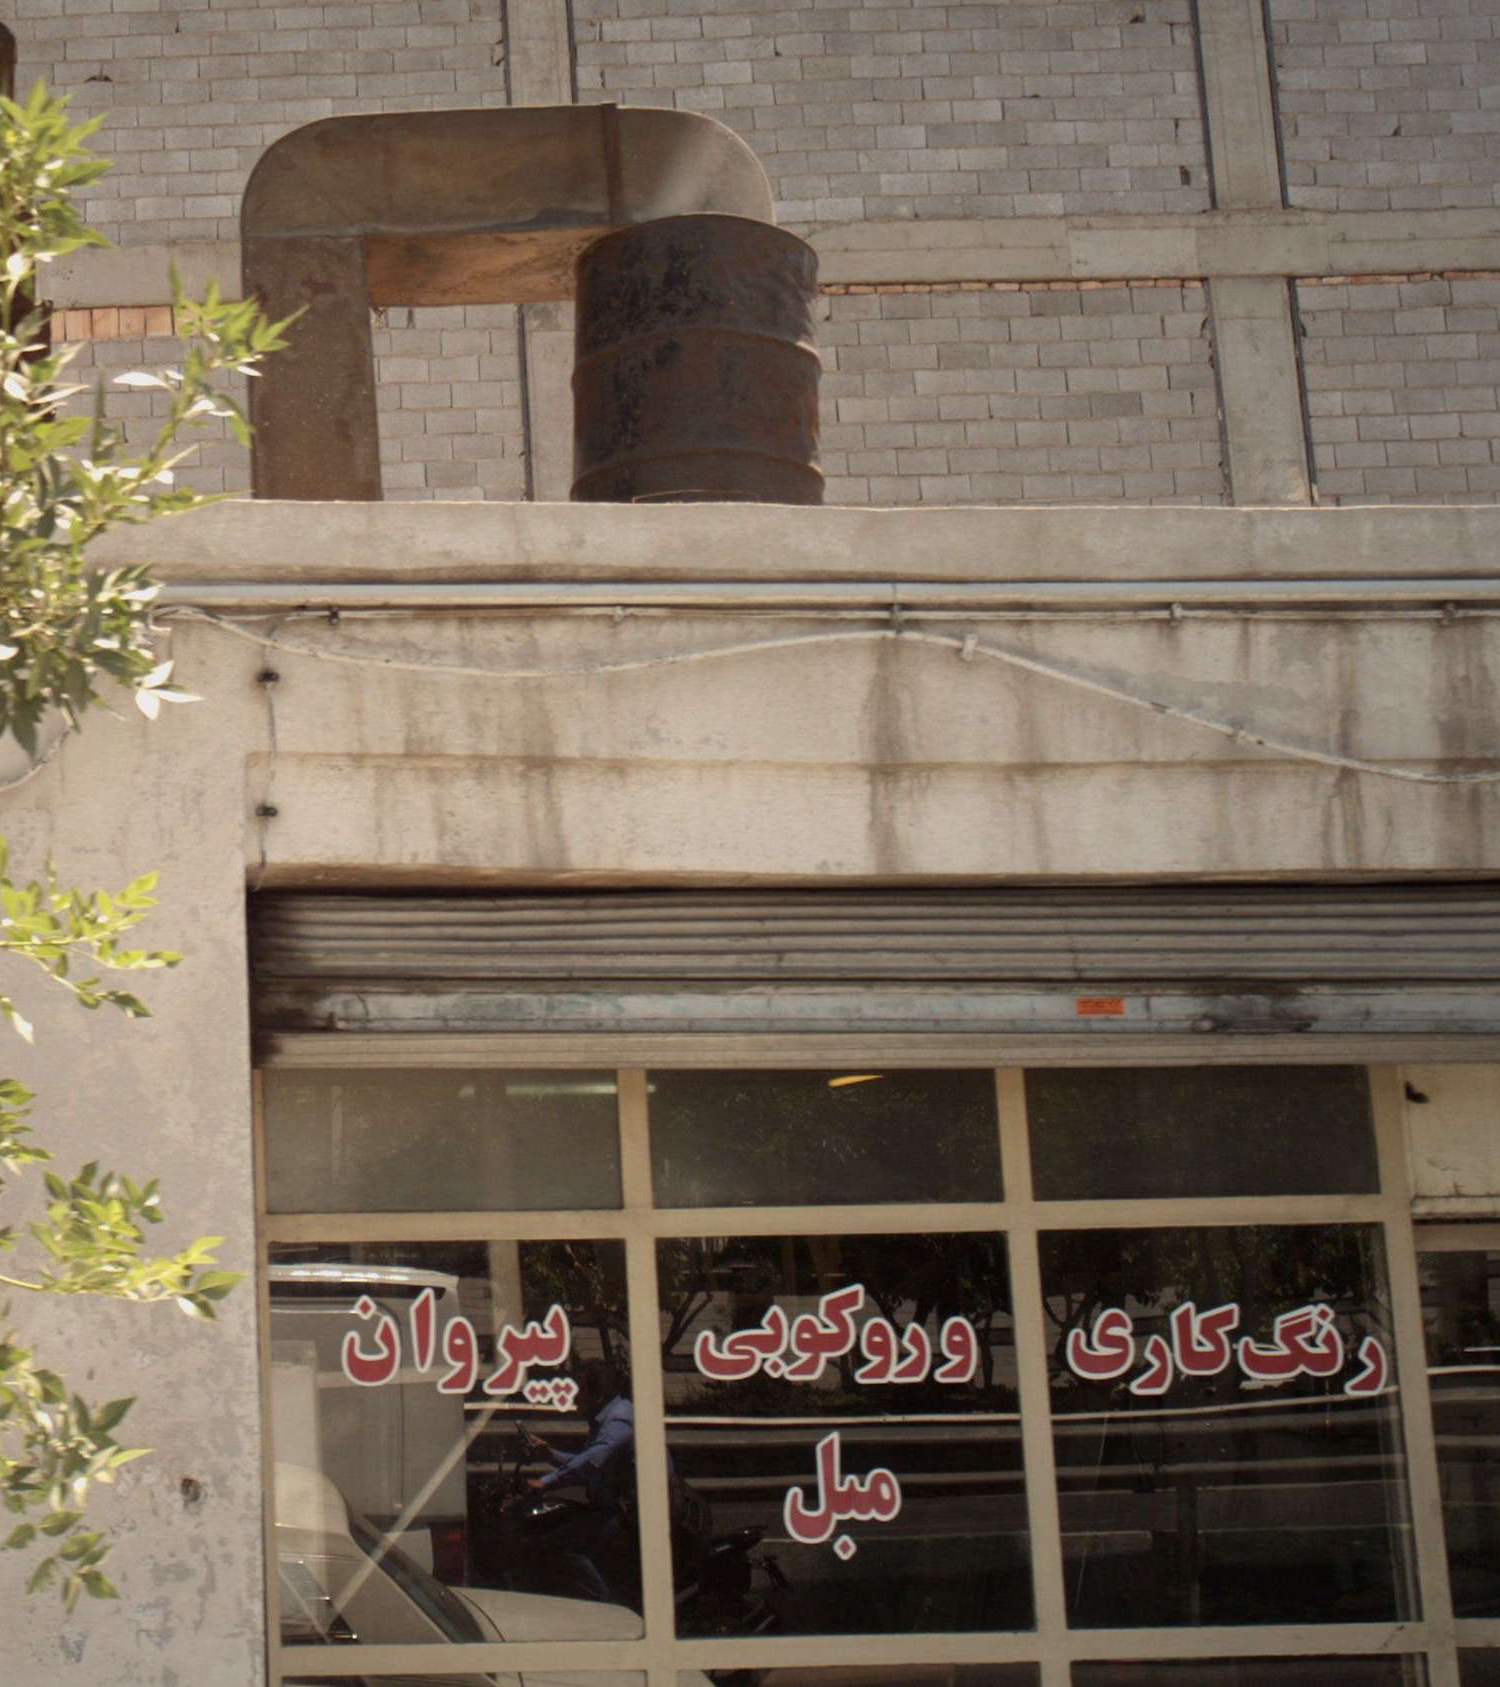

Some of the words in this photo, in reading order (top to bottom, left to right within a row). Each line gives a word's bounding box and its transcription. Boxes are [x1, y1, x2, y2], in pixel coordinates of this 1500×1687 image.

[342, 1287, 579, 1413] پیروان
[1066, 1301, 1239, 1395] کاری
[1237, 1304, 1388, 1396] رنگ
[783, 1431, 901, 1561] مبل
